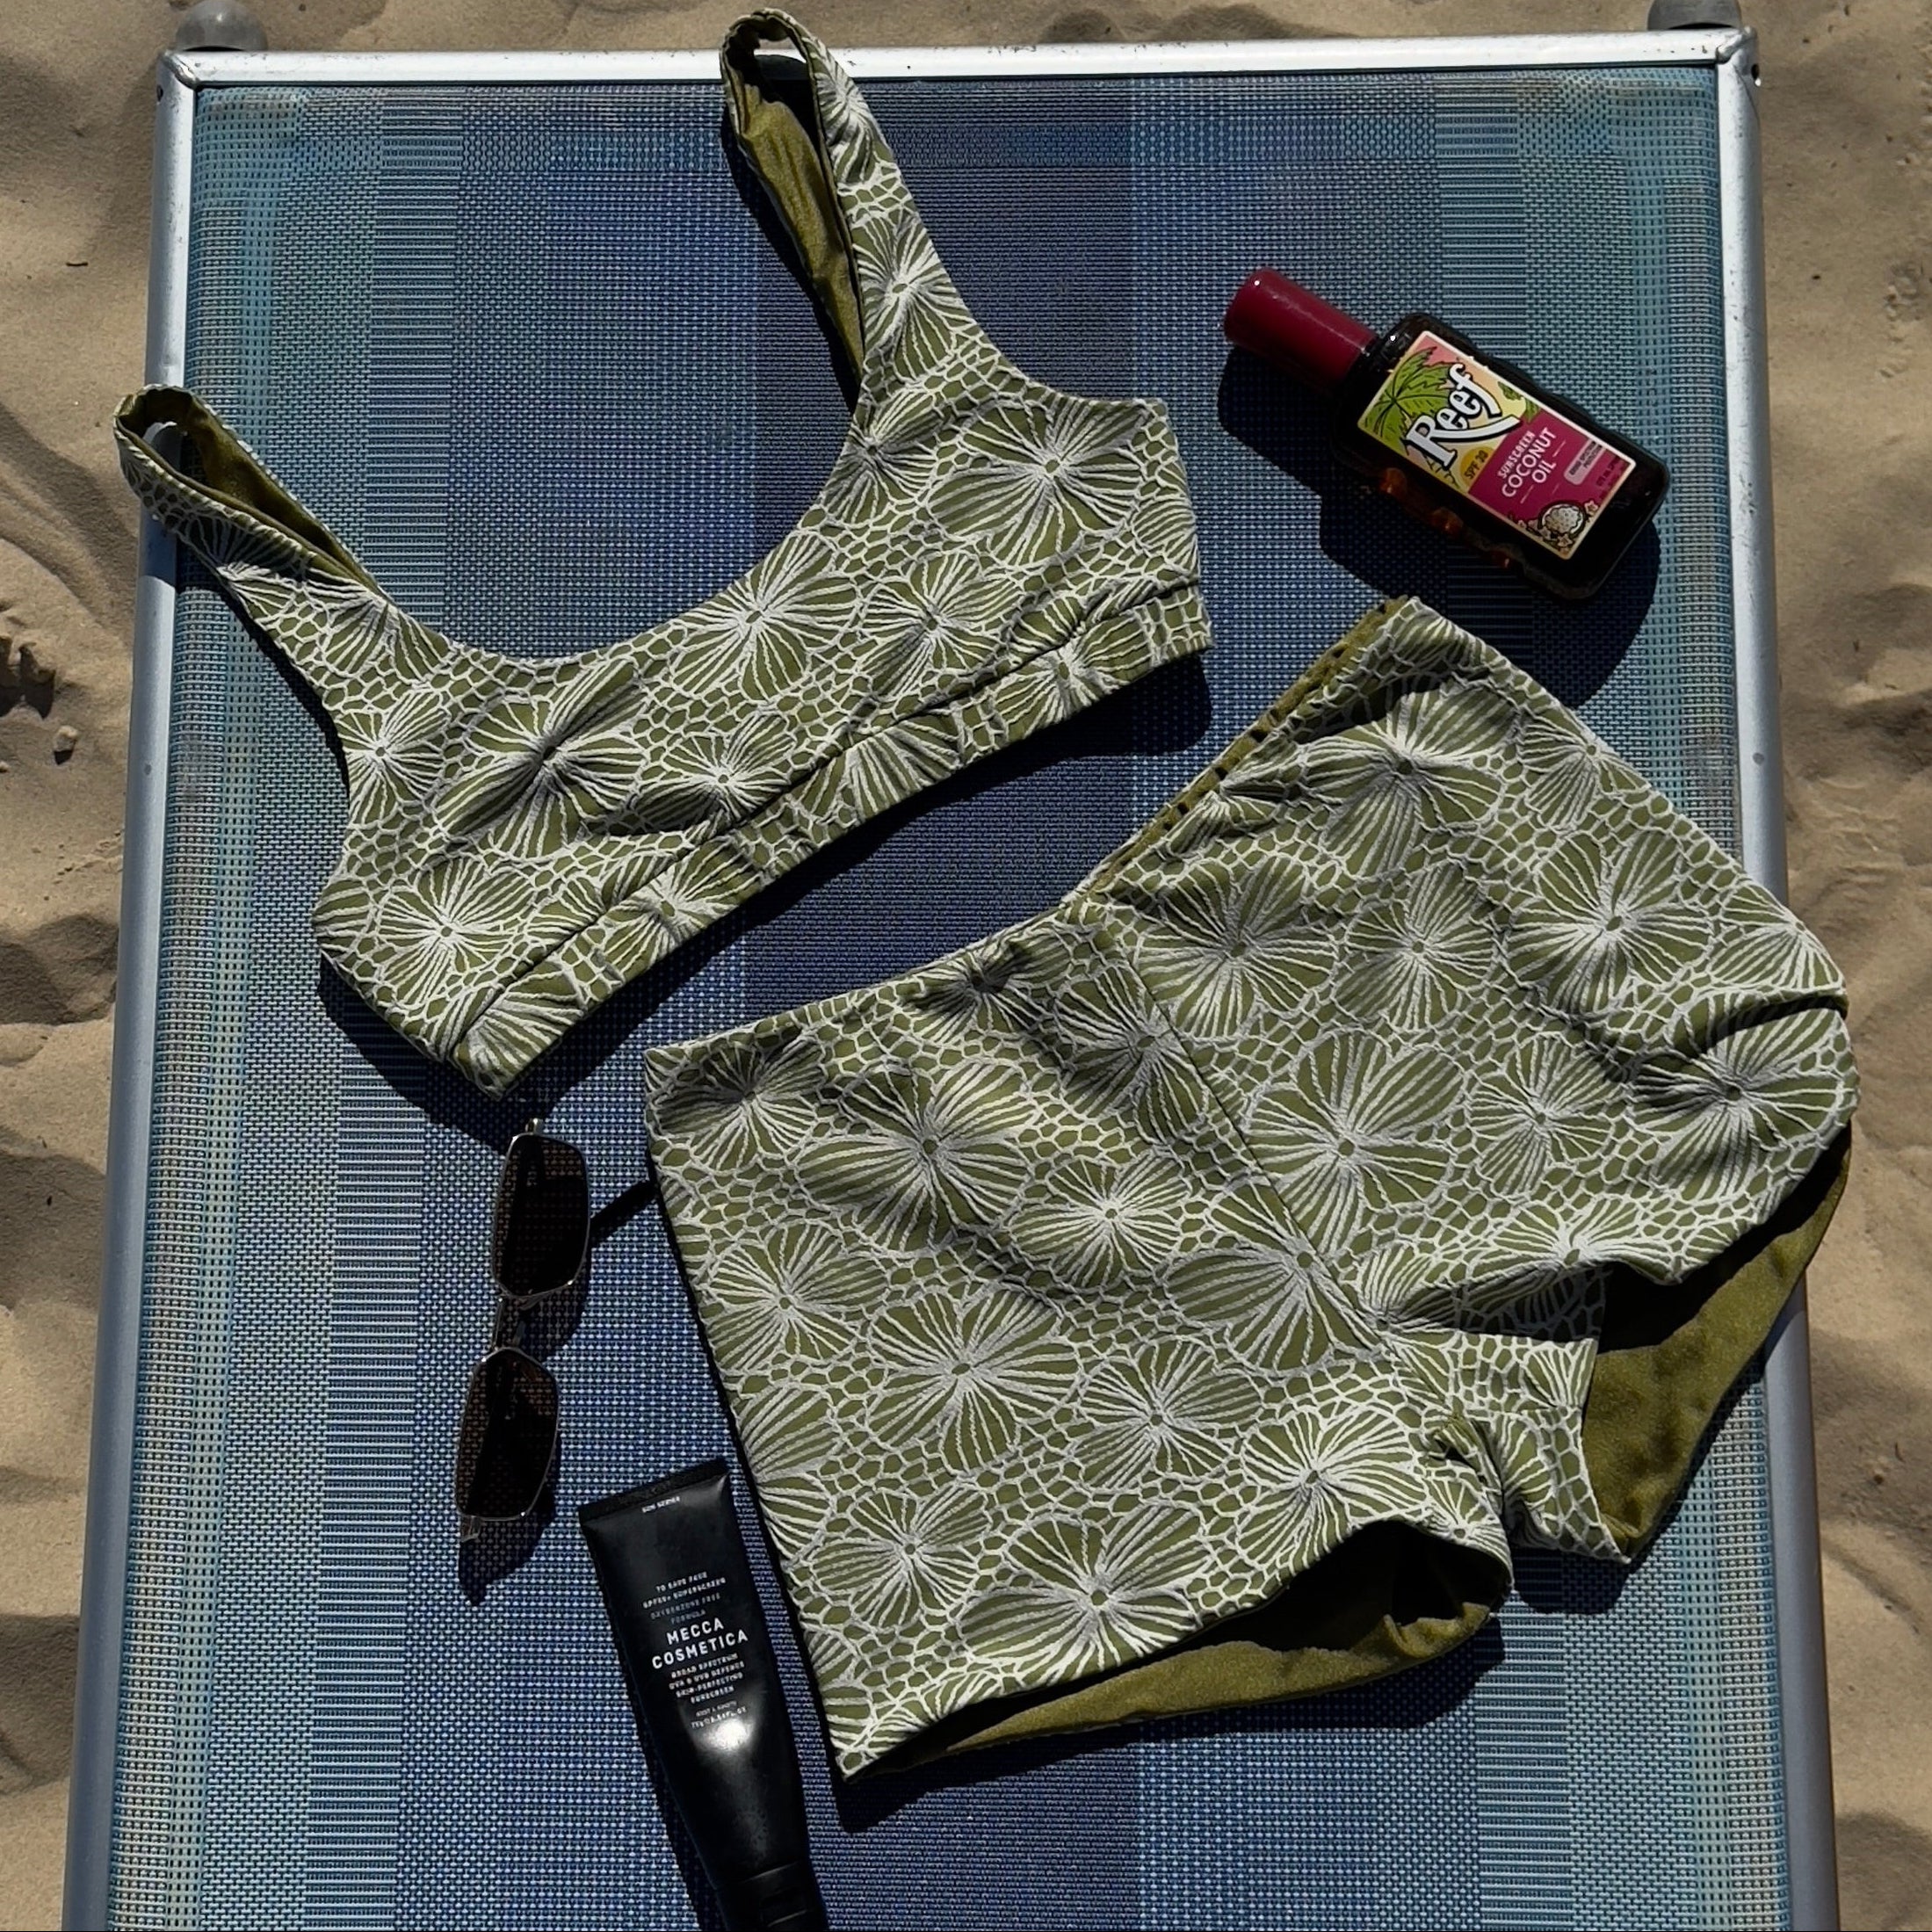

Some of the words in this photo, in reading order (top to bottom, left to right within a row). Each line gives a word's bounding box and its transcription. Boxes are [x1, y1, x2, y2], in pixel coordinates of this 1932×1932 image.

[1407, 363, 1521, 467] Reef
[1465, 461, 1480, 480] SPF
[1497, 430, 1536, 479] SUNSCREEN
[1501, 427, 1557, 497] COCONUT
[1531, 459, 1557, 483] OIL
[652, 1629, 749, 1669] COSMETICA
[666, 1617, 724, 1645] MECCA
